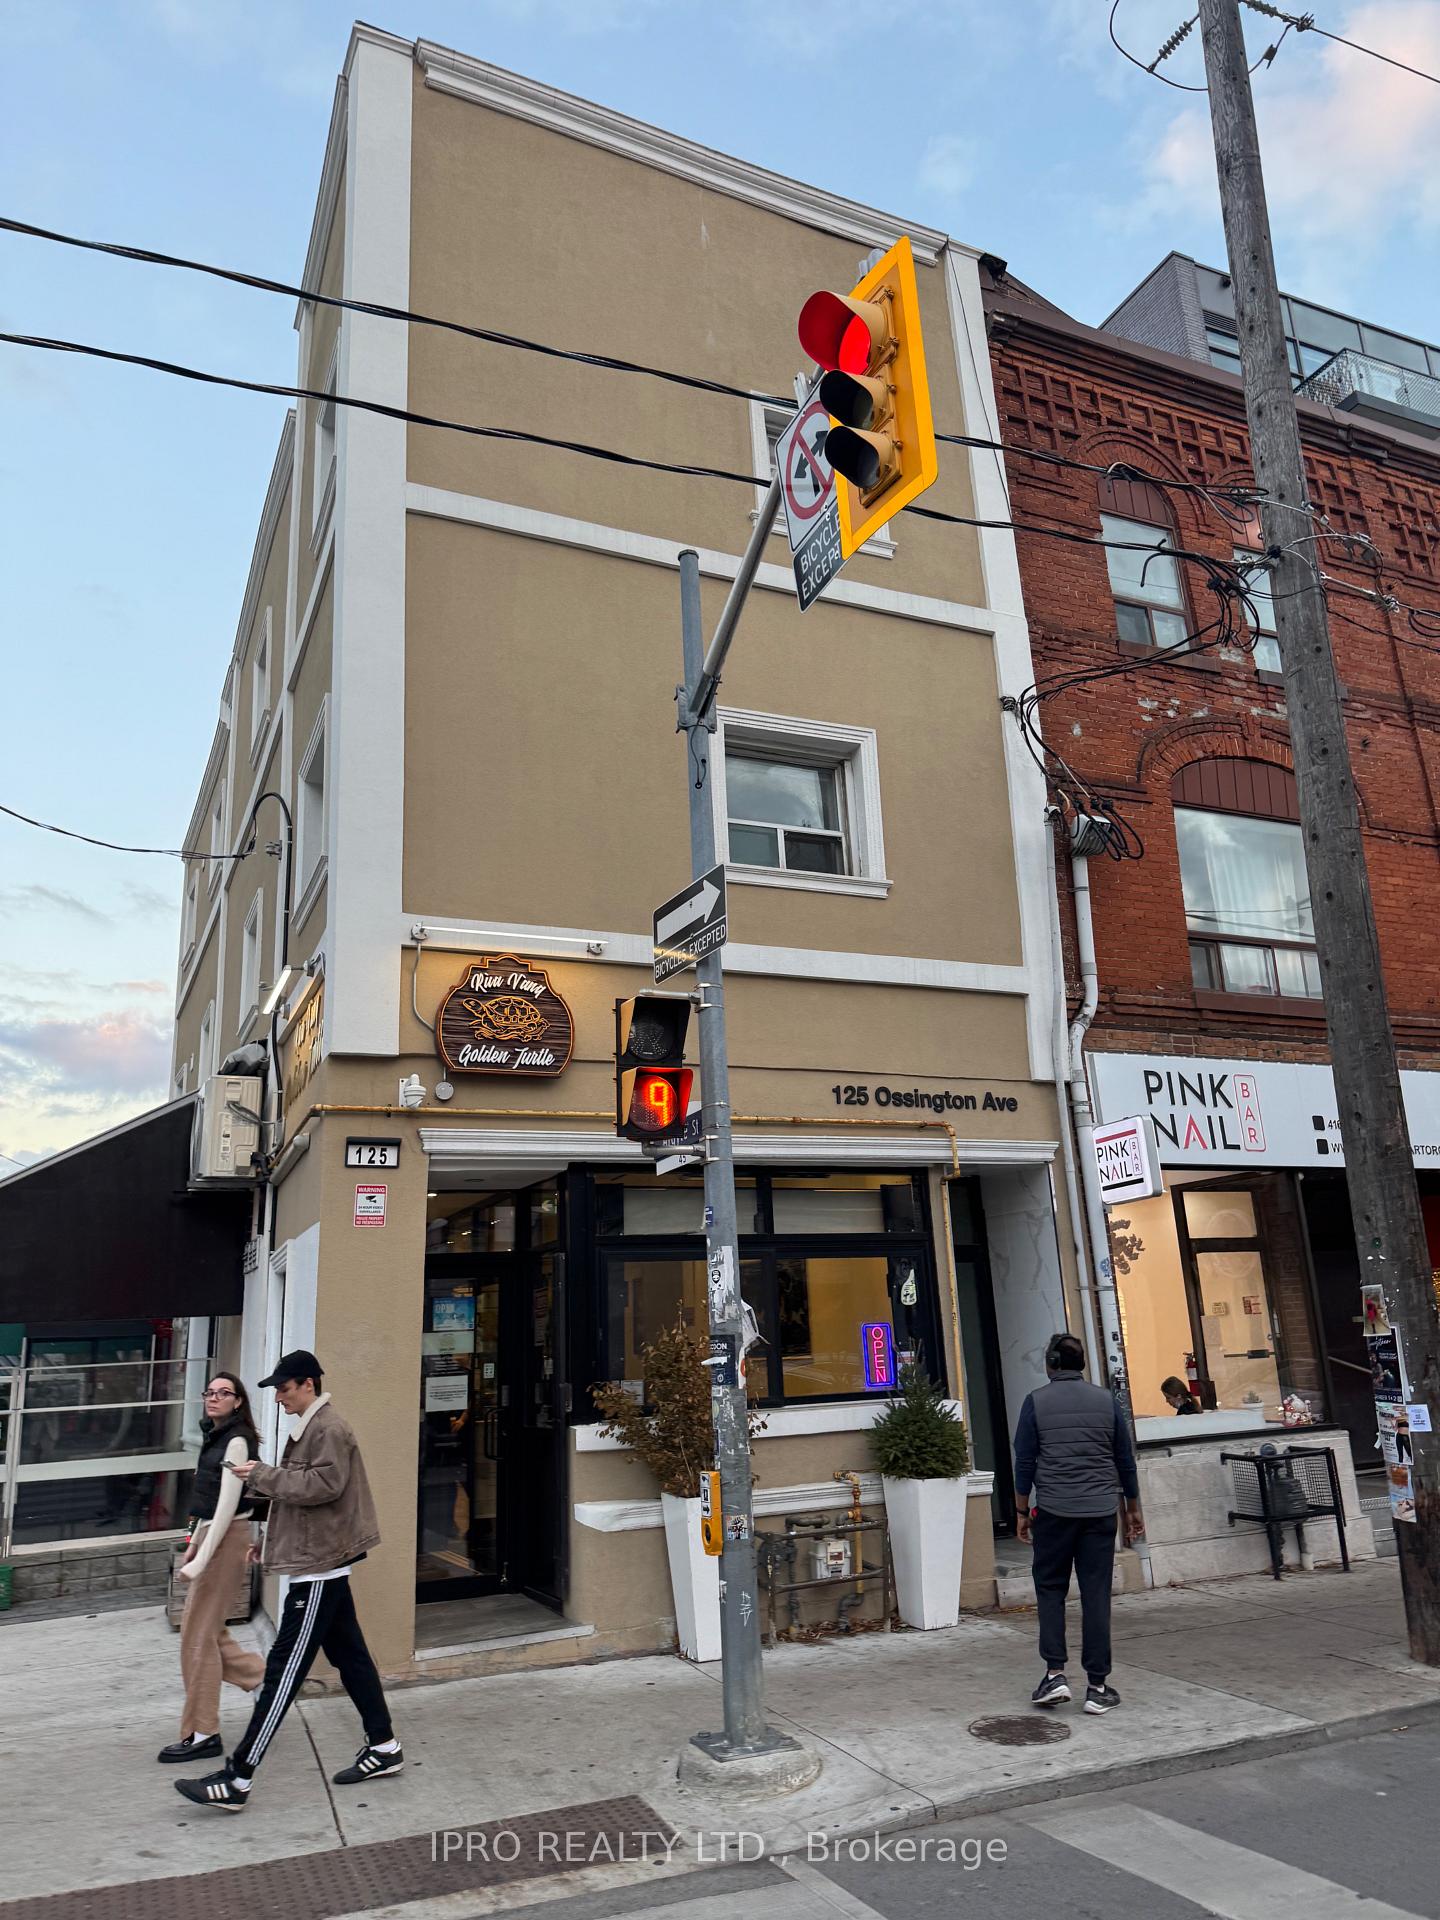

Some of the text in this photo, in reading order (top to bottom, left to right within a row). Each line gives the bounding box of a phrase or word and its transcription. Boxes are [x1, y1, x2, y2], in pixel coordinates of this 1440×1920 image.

[655, 924, 726, 978] BICYCLES EXCEPTED
[459, 1044, 555, 1069] Golden Turtle
[650, 1082, 668, 1126] 9
[832, 1085, 1018, 1113] 125 Ossington Ave
[1143, 1070, 1233, 1108] PINK
[1240, 1083, 1259, 1143] BAR
[1150, 1112, 1240, 1150] NAIL
[356, 1147, 387, 1165] 125
[1097, 1140, 1130, 1163] PINK
[1131, 1141, 1140, 1172] BAR
[1100, 1161, 1132, 1183] NAIL
[871, 1326, 887, 1383] OPEN
